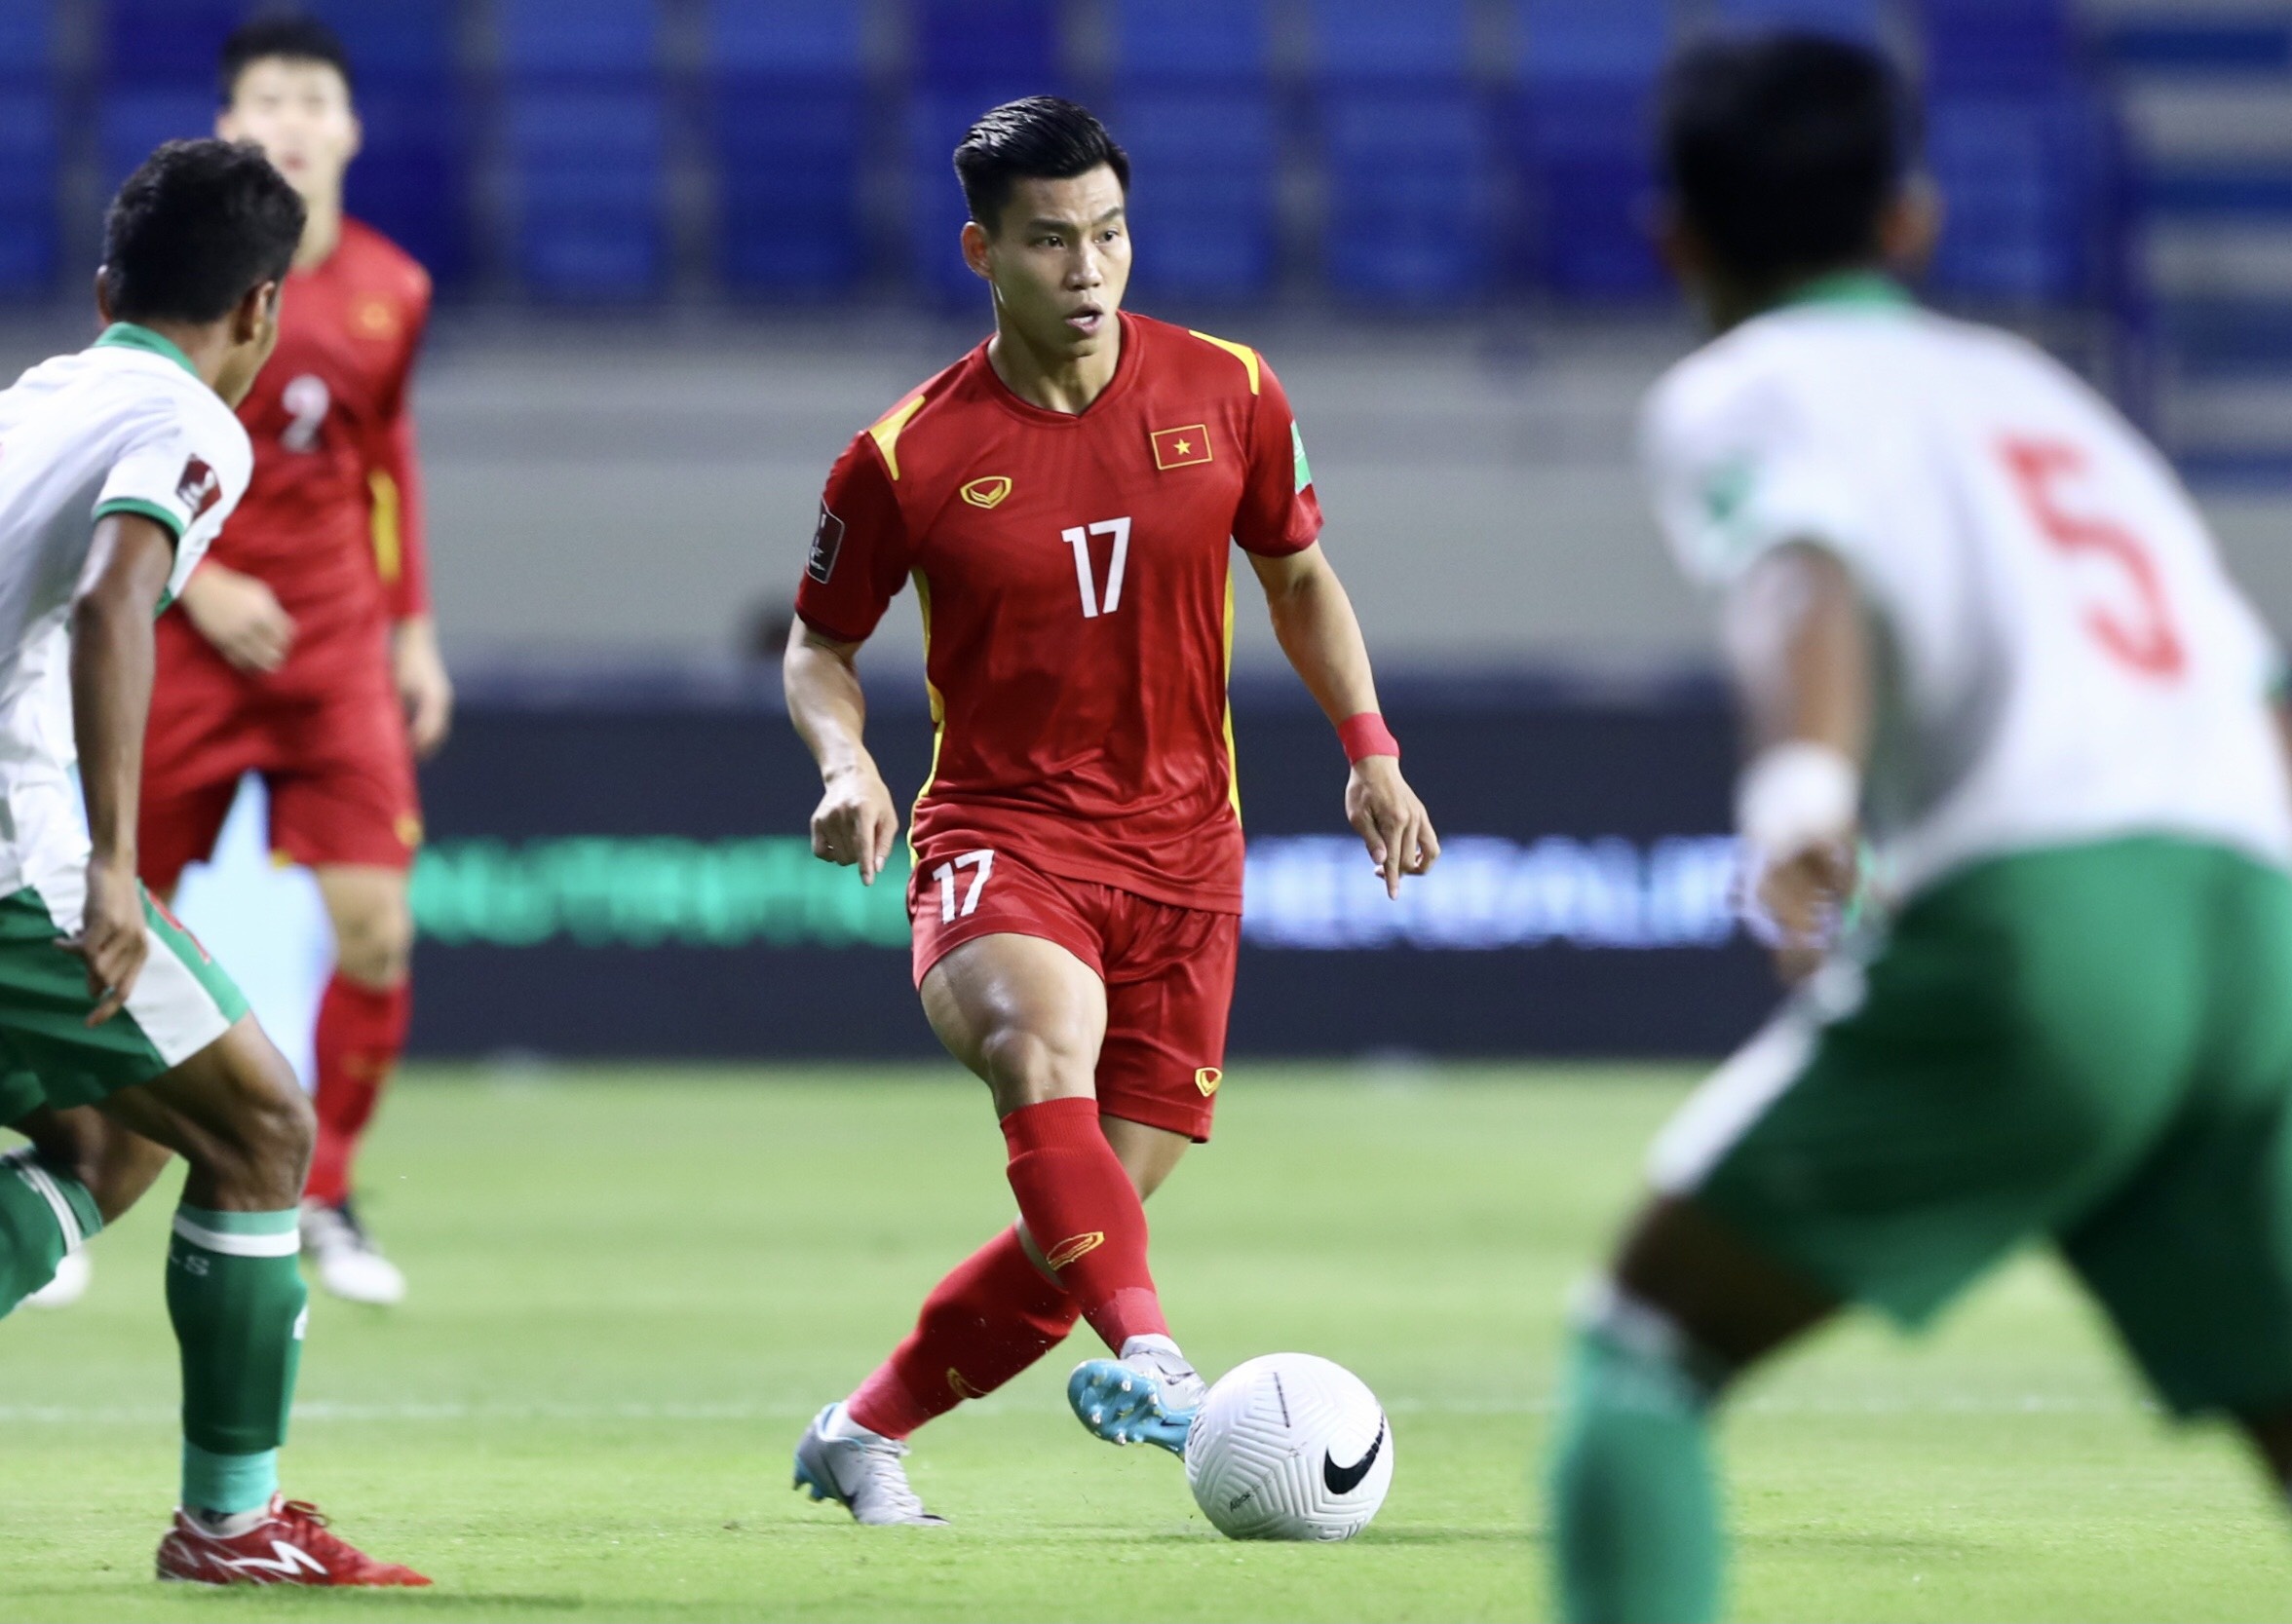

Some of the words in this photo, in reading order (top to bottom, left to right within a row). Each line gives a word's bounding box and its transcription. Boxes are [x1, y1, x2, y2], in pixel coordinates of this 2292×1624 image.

[1060, 515, 1132, 619] 17
[1994, 436, 2189, 686] 5
[932, 849, 995, 925] 17
